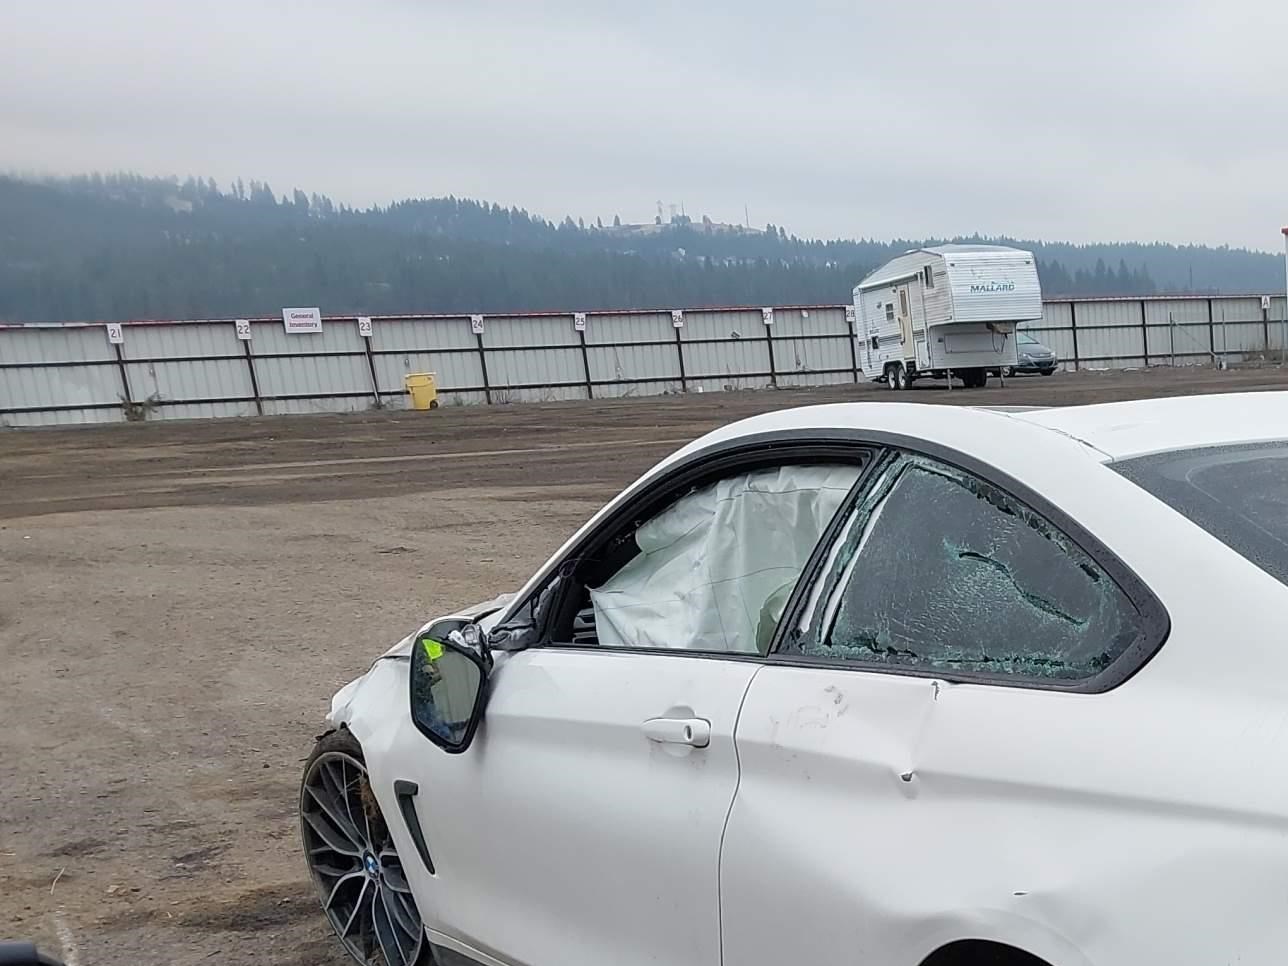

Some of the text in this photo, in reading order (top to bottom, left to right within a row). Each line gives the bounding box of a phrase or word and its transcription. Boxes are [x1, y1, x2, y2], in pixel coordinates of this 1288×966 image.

[970, 283, 1015, 294] MALLARD
[672, 314, 683, 322] 26
[763, 311, 772, 320] 27
[360, 321, 371, 331] 23
[472, 319, 483, 329] 24
[575, 317, 585, 326] 25
[110, 328, 121, 338] 21
[238, 324, 250, 335] 22
